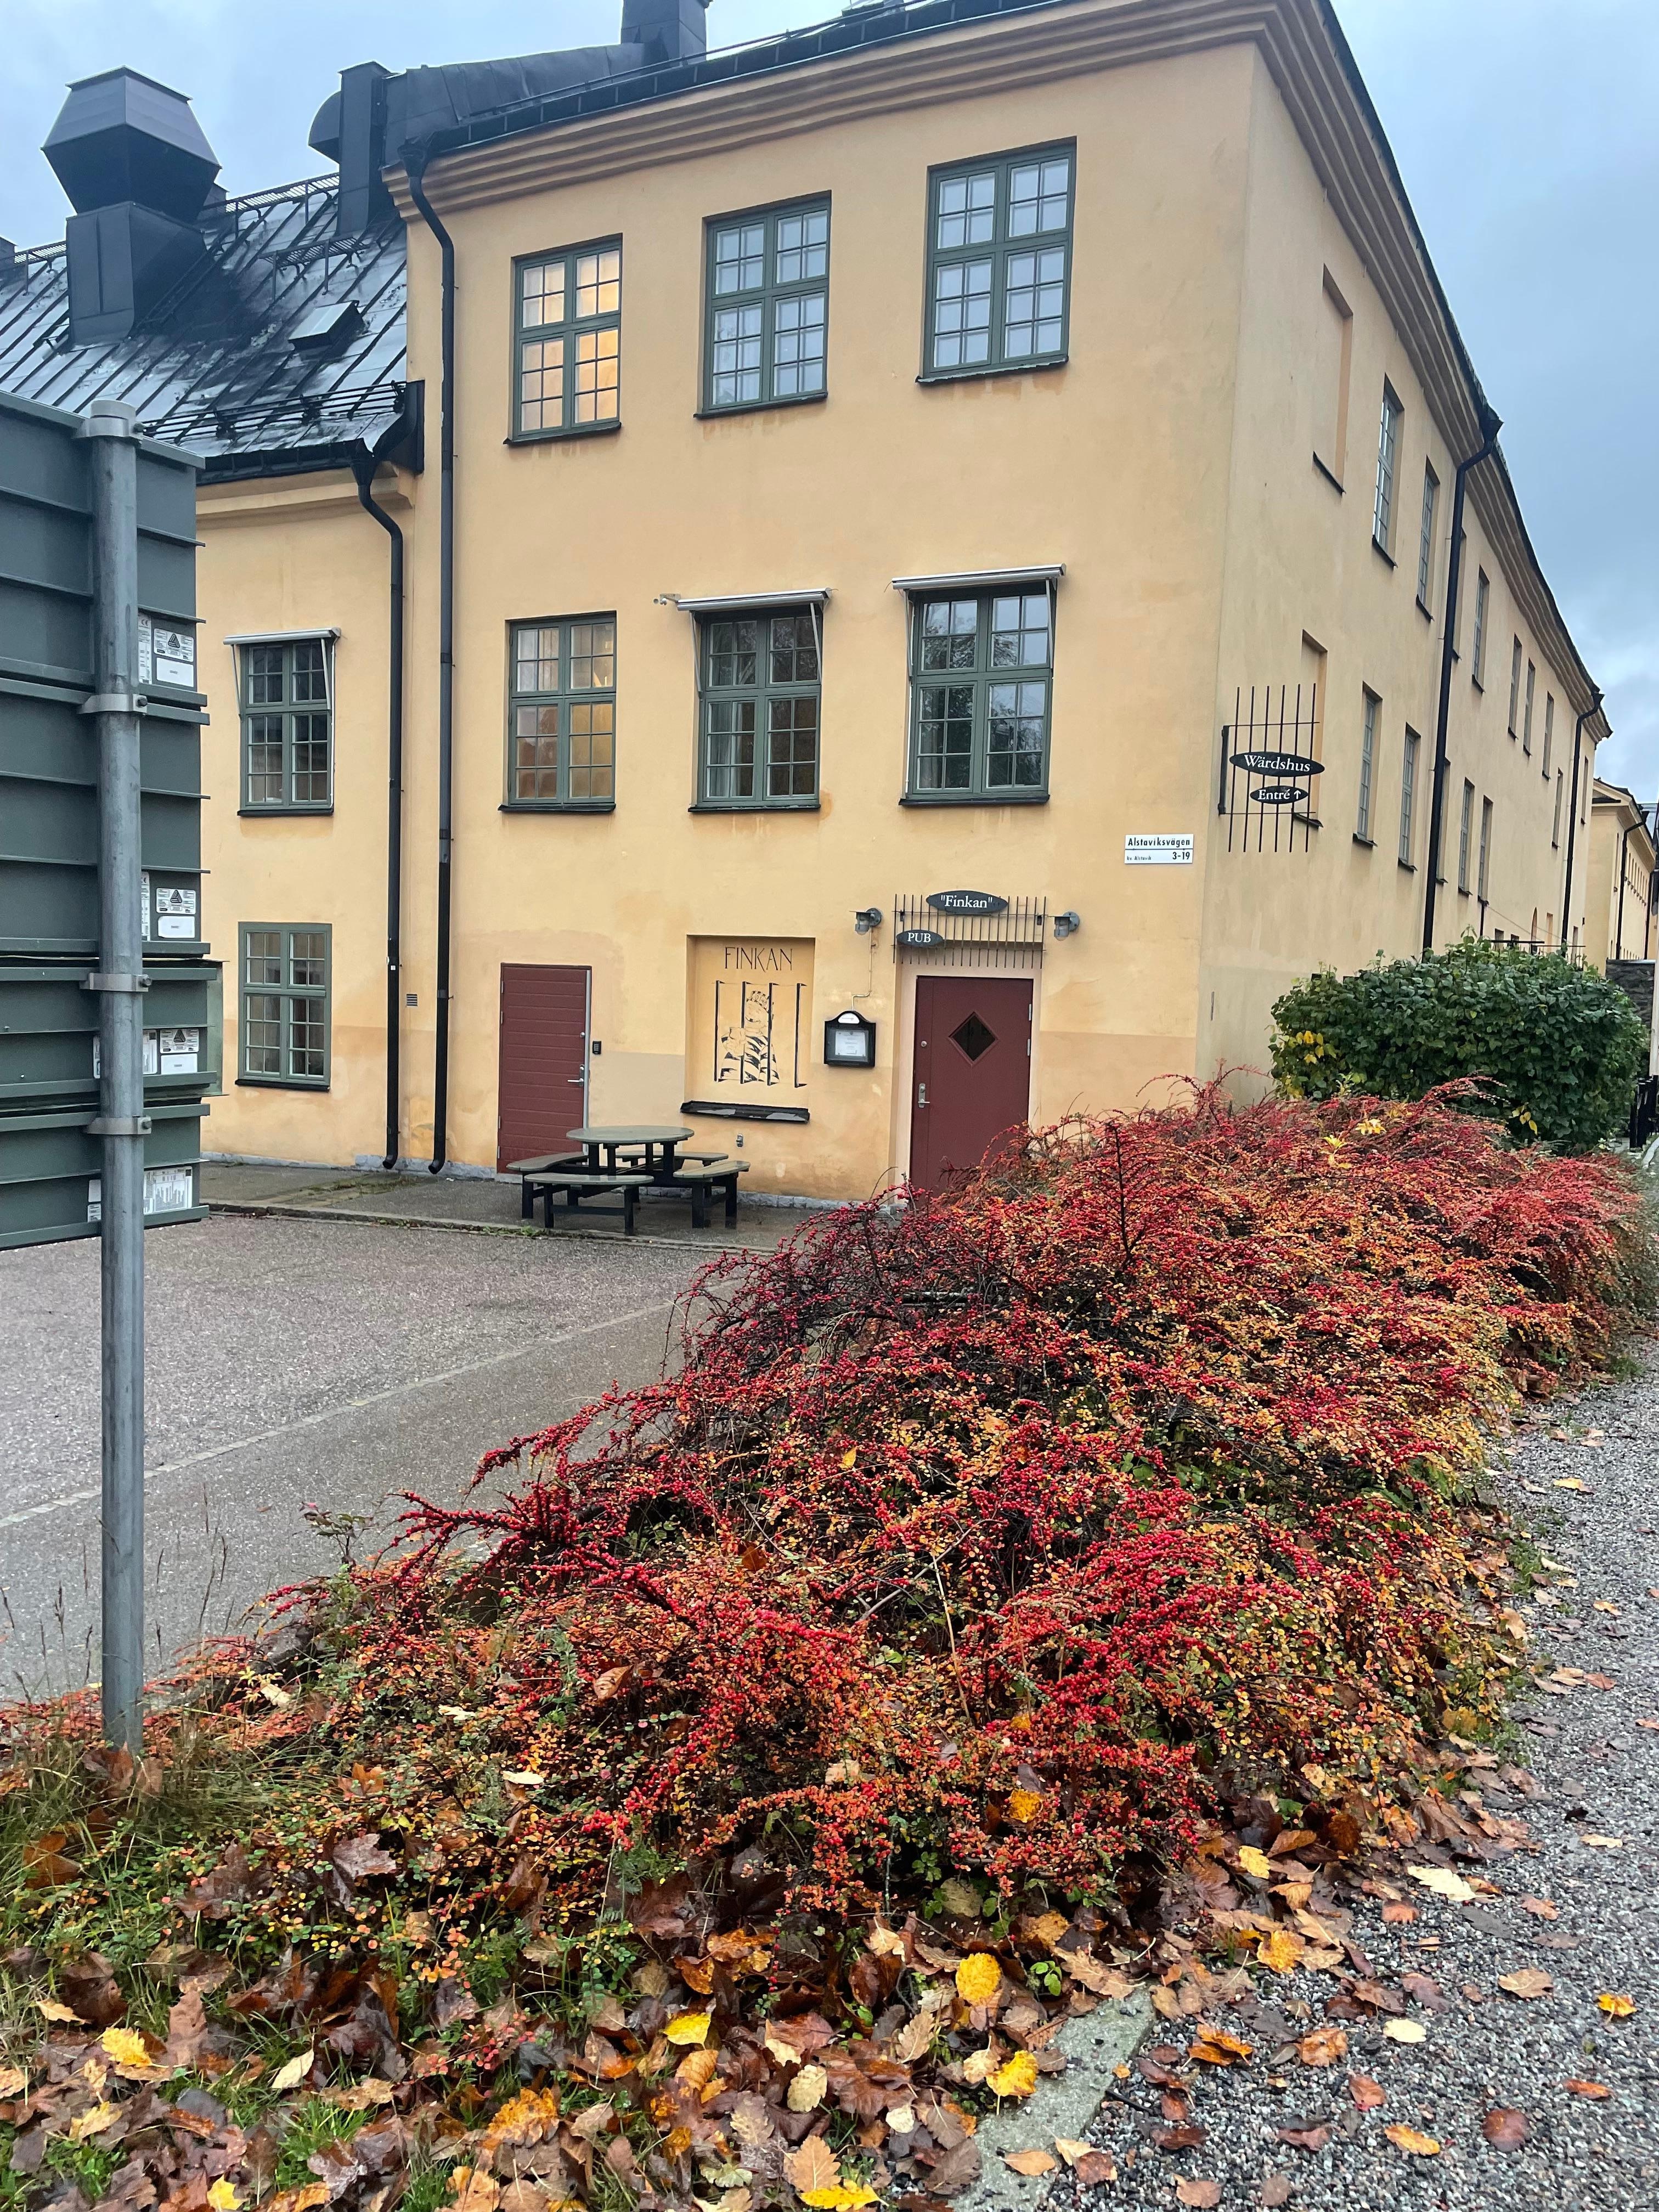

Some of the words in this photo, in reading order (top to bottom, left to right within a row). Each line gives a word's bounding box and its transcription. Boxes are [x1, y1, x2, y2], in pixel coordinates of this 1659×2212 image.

[1244, 754, 1311, 772] Wärdshus
[1257, 788, 1290, 800] Entré
[1127, 837, 1190, 848] Alstaviksvägen
[1172, 851, 1190, 860] 3-19
[940, 894, 993, 909] "Finkan"
[907, 932, 932, 943] PUB
[724, 946, 793, 973] FINKAN
